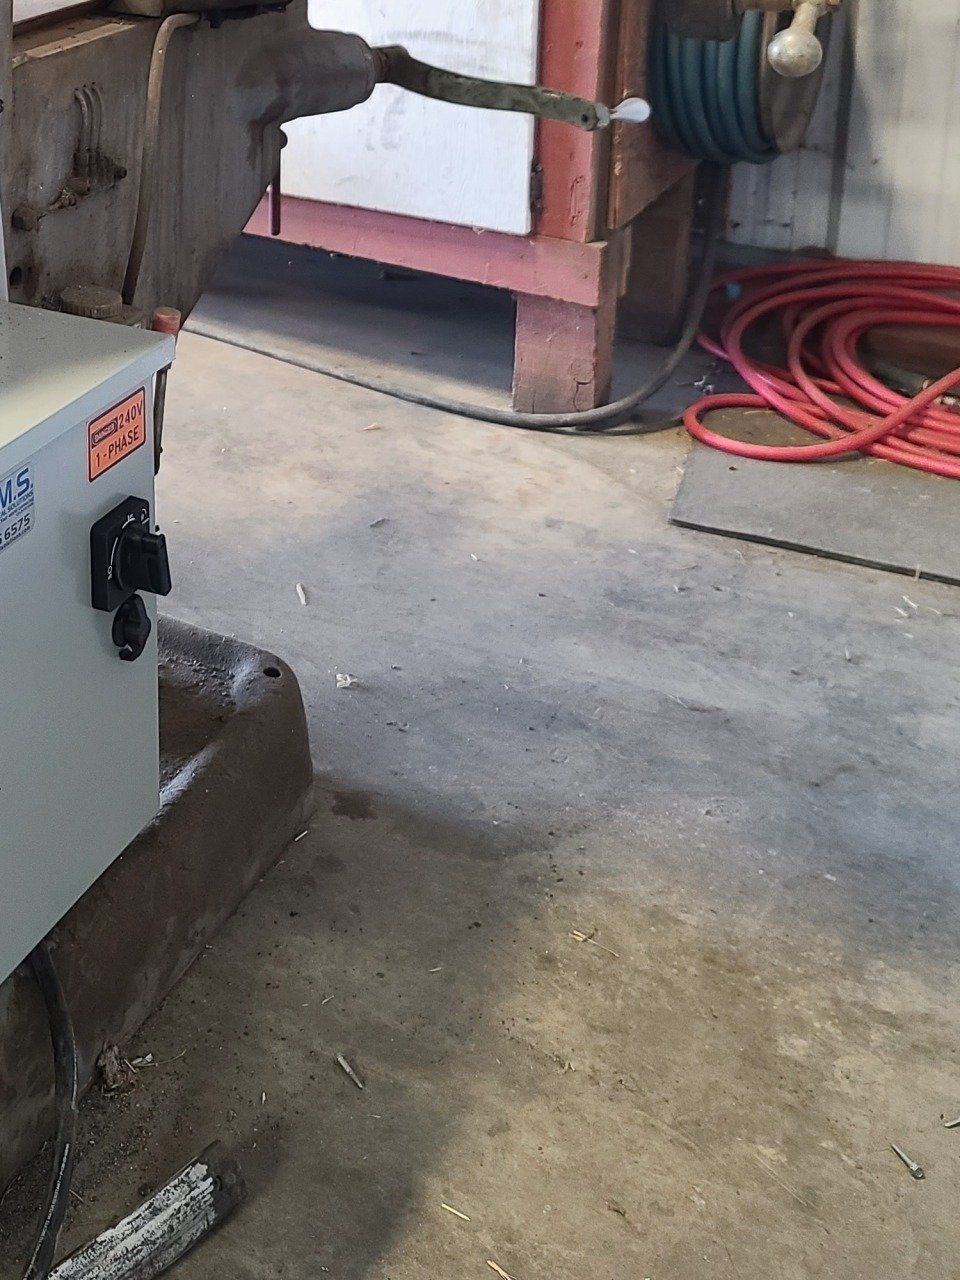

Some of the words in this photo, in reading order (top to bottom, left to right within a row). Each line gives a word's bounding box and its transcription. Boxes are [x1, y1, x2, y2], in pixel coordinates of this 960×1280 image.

[118, 399, 143, 430] 240V
[7, 490, 34, 513] SOLUTIONS
[3, 512, 31, 540] 6575
